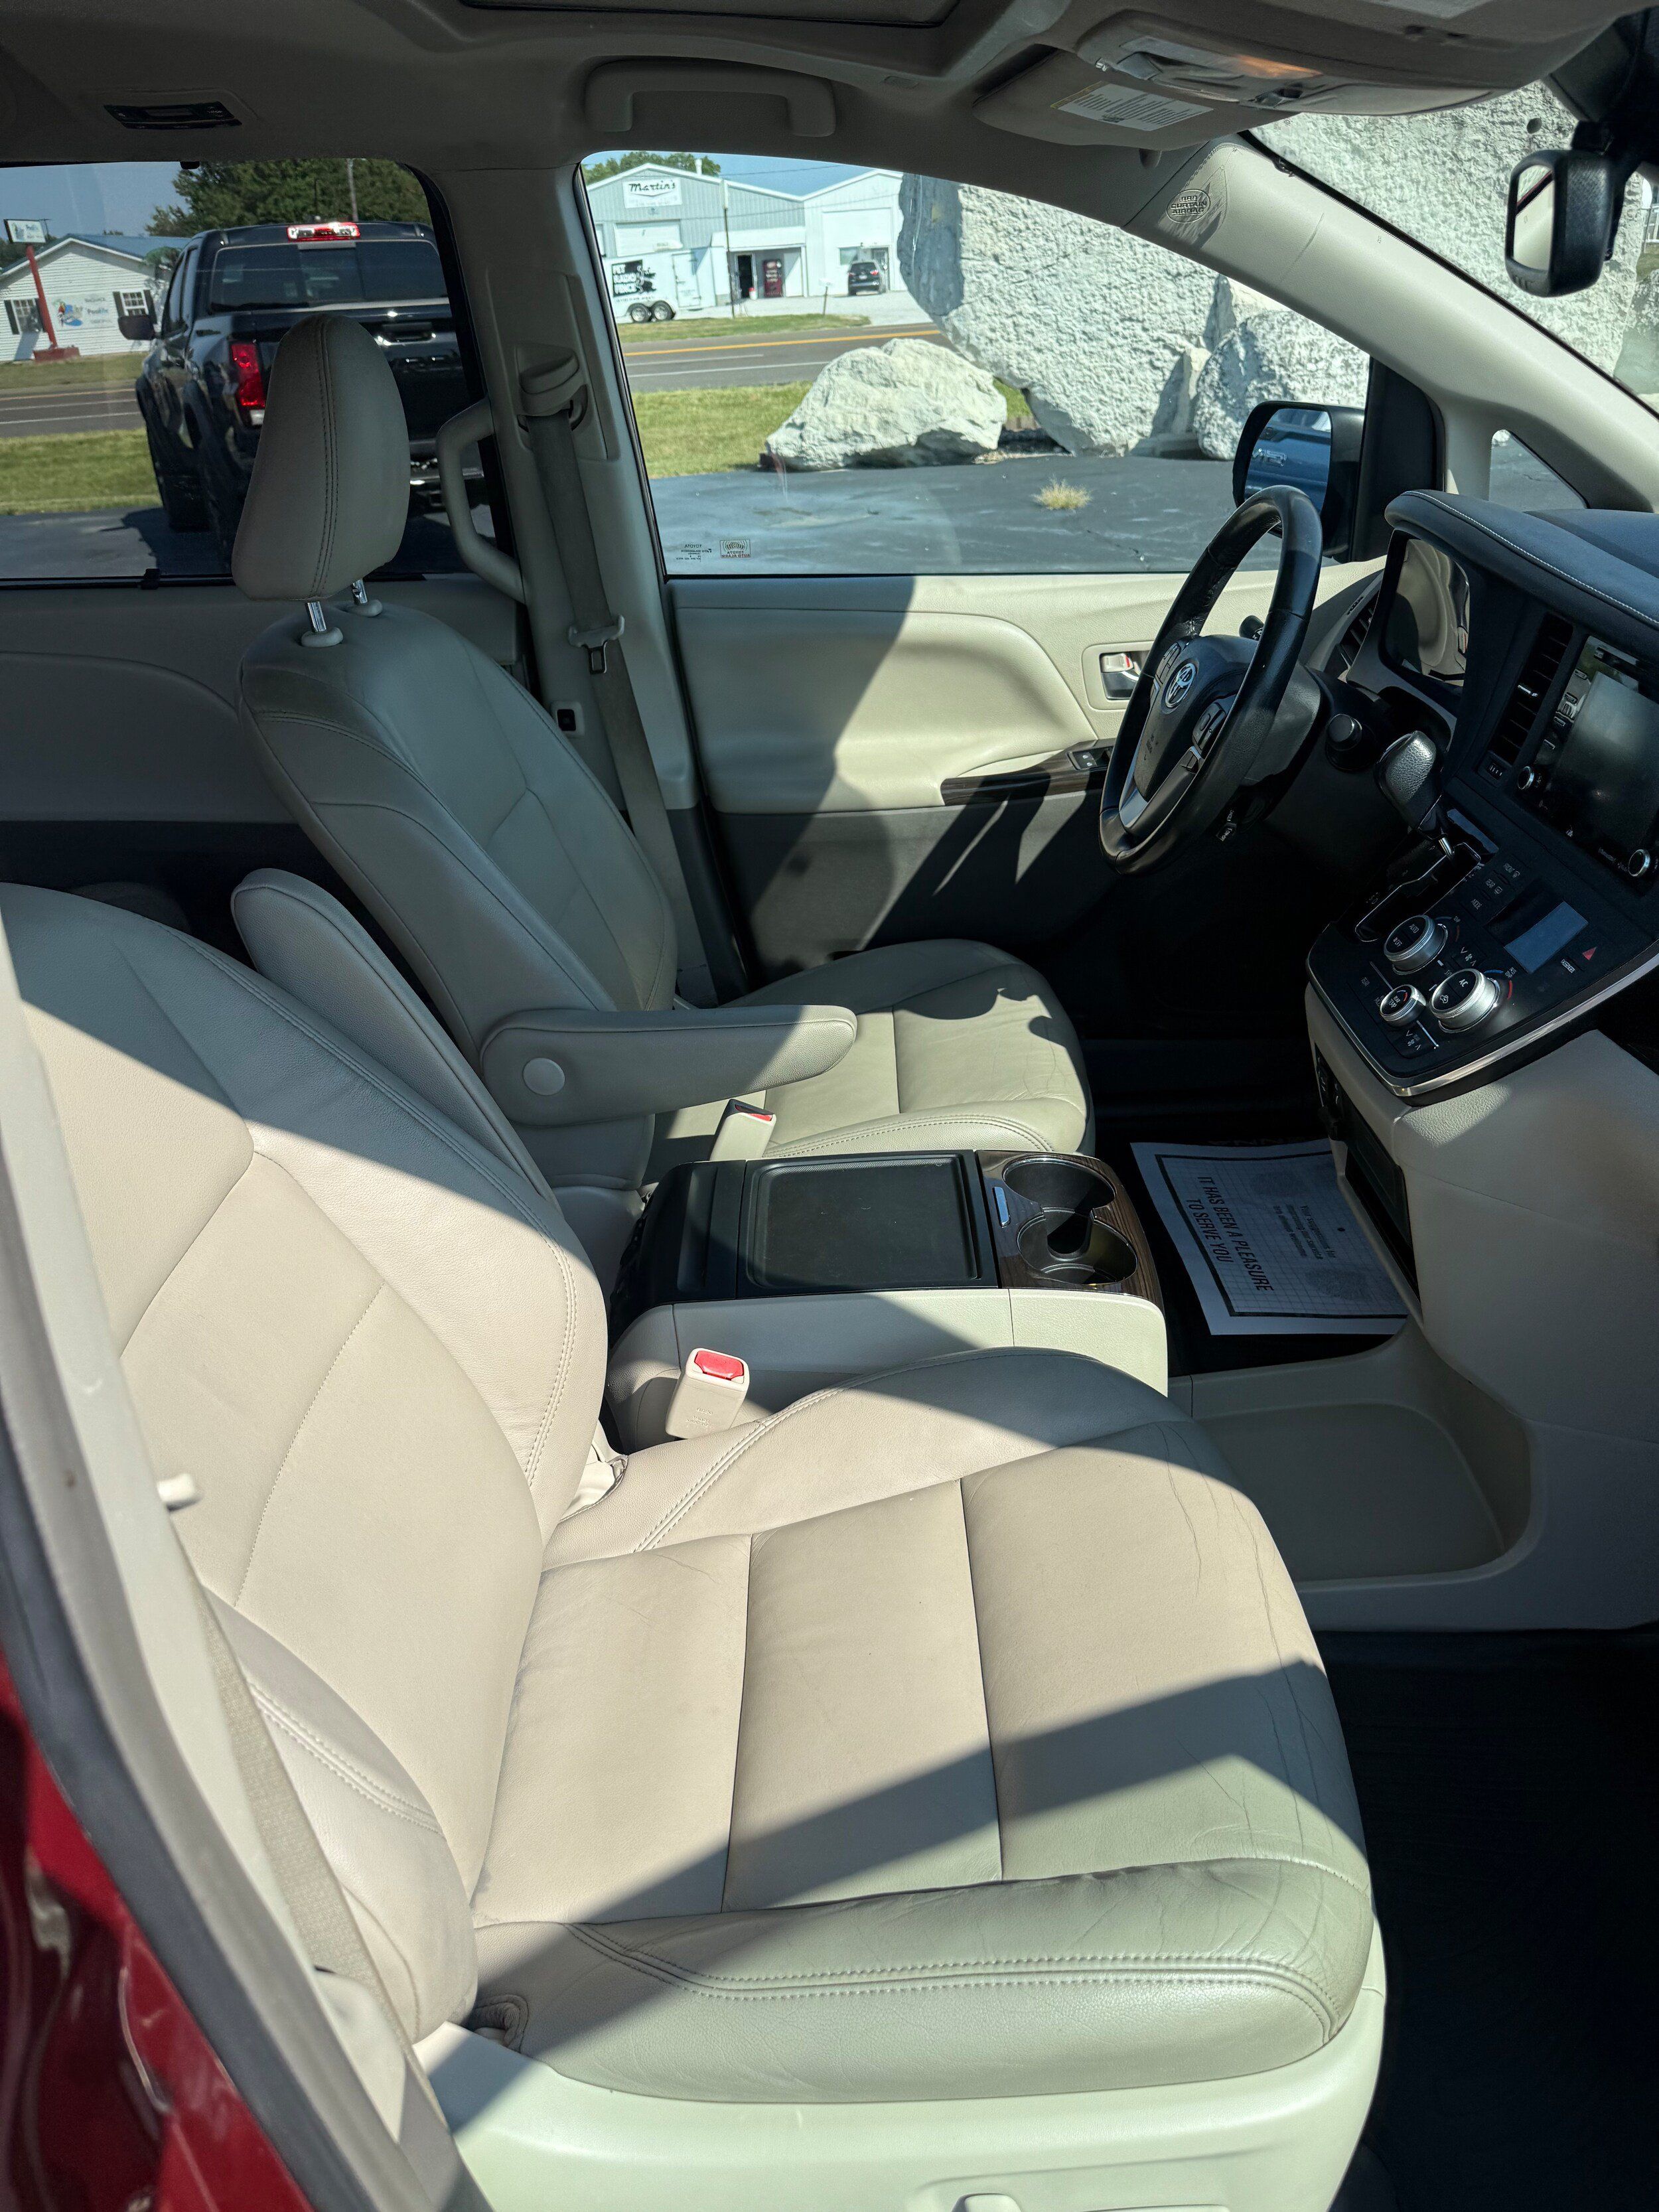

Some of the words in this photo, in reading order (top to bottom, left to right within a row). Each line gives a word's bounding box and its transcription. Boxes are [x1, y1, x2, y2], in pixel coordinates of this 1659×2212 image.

[628, 180, 676, 192] Martin's
[1197, 1176, 1216, 1185] IT
[1186, 1199, 1205, 1211] TO
[1202, 1186, 1225, 1205] HAS
[1192, 1213, 1222, 1241] SERVE
[1213, 1207, 1239, 1228] BEEN
[1209, 1242, 1234, 1263] YOU
[1231, 1239, 1275, 1291] PLEASURE
